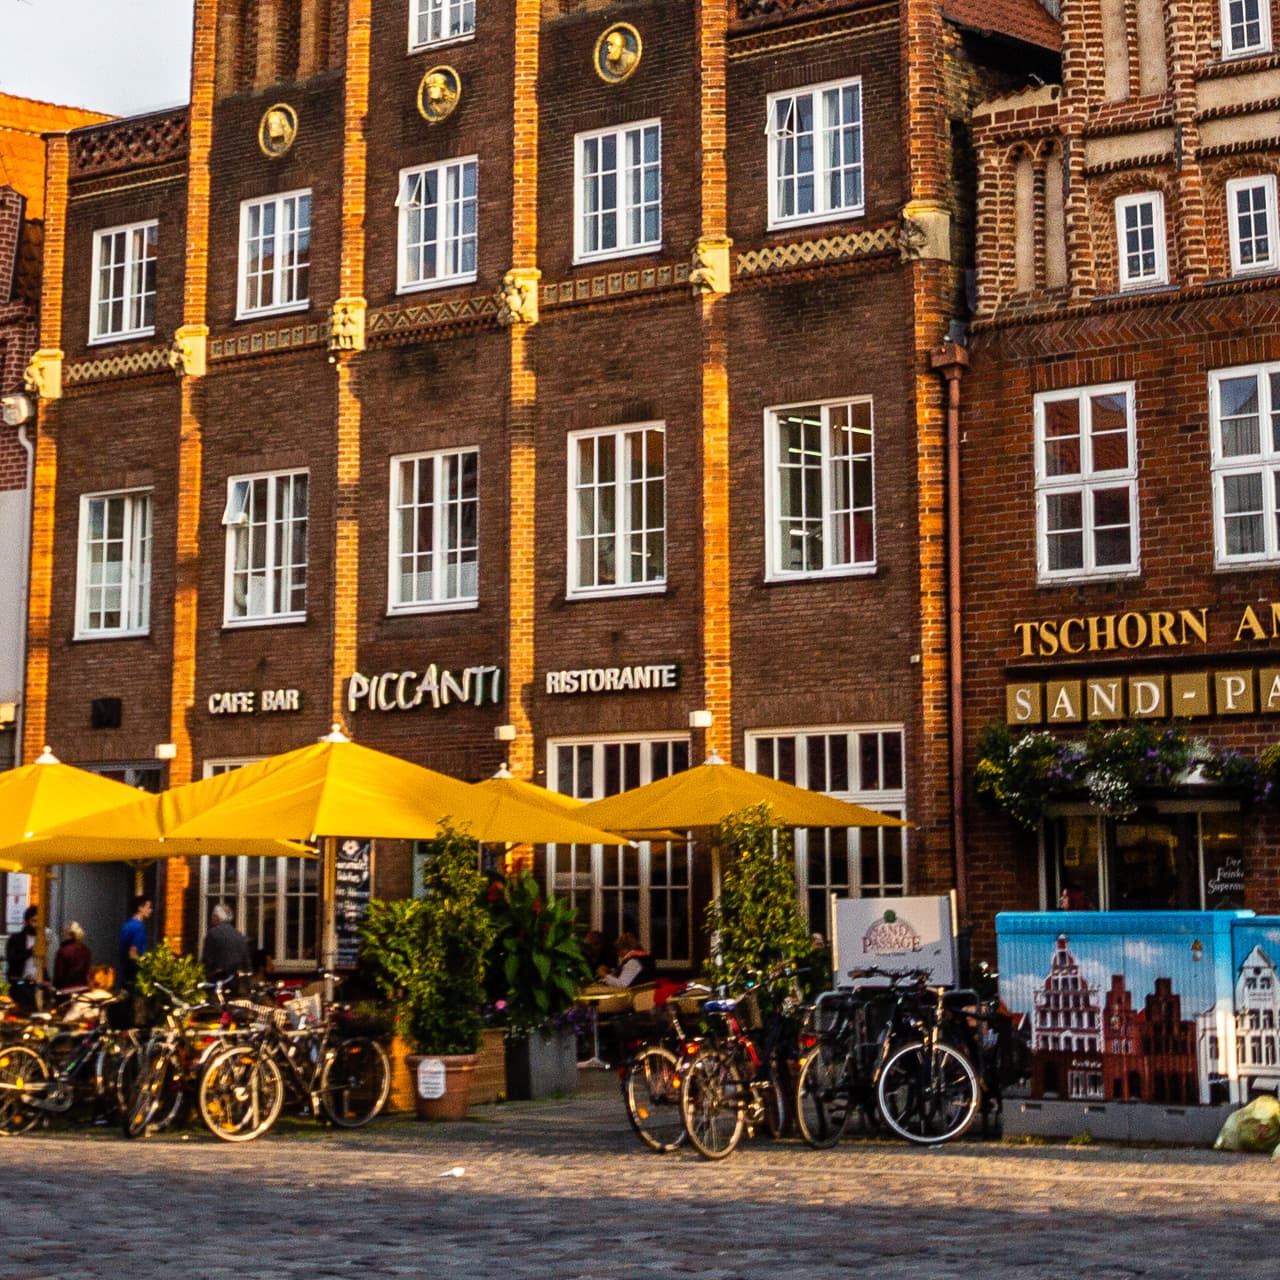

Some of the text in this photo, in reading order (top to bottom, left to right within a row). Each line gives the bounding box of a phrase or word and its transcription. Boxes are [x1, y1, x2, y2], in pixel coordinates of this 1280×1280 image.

[1015, 607, 1208, 657] TSCHORN
[348, 664, 500, 711] PICCANTI
[546, 664, 677, 694] RISTORANTE
[209, 689, 299, 714] CAFE BAR
